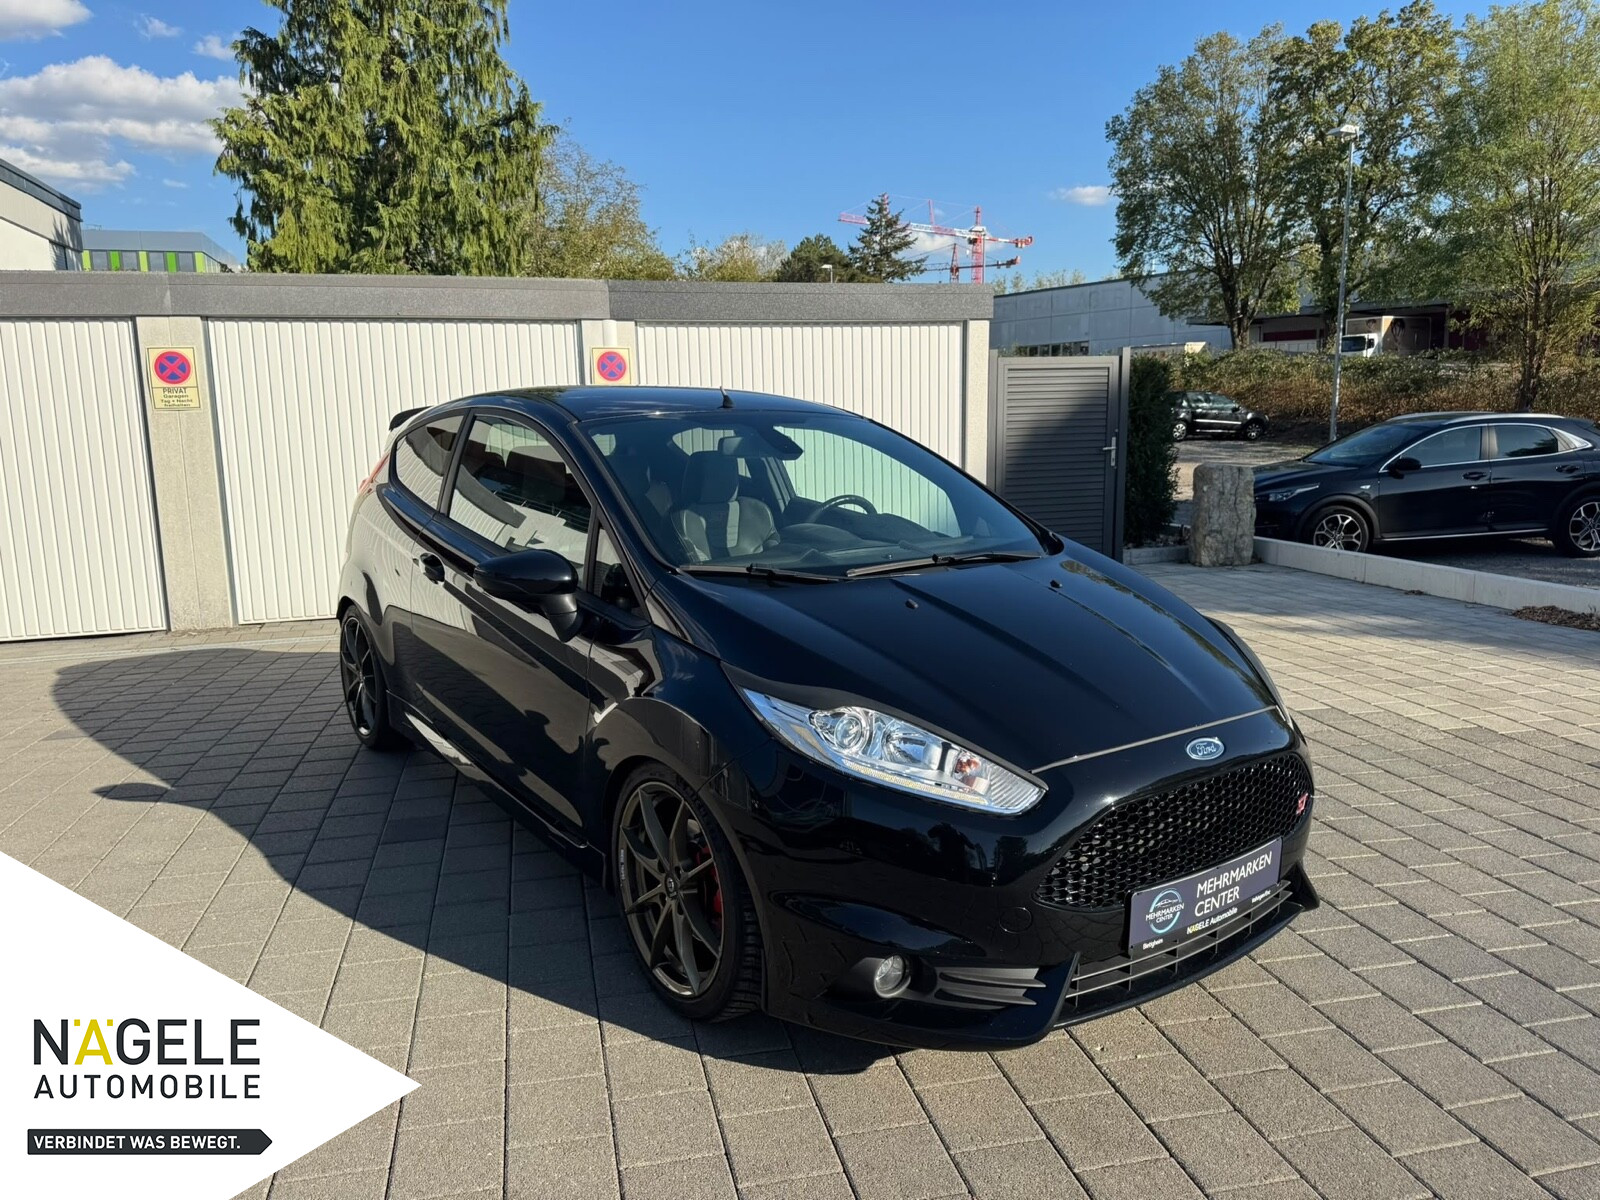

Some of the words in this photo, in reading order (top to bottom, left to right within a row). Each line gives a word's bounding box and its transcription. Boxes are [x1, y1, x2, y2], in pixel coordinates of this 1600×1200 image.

[1195, 742, 1217, 756] Ford
[1196, 851, 1272, 899] MEHRMARKEN
[1194, 886, 1240, 917] CENTER
[1145, 902, 1185, 922] MEHRMARKEN
[1155, 913, 1173, 924] CENTER
[1209, 907, 1238, 926] Automobile
